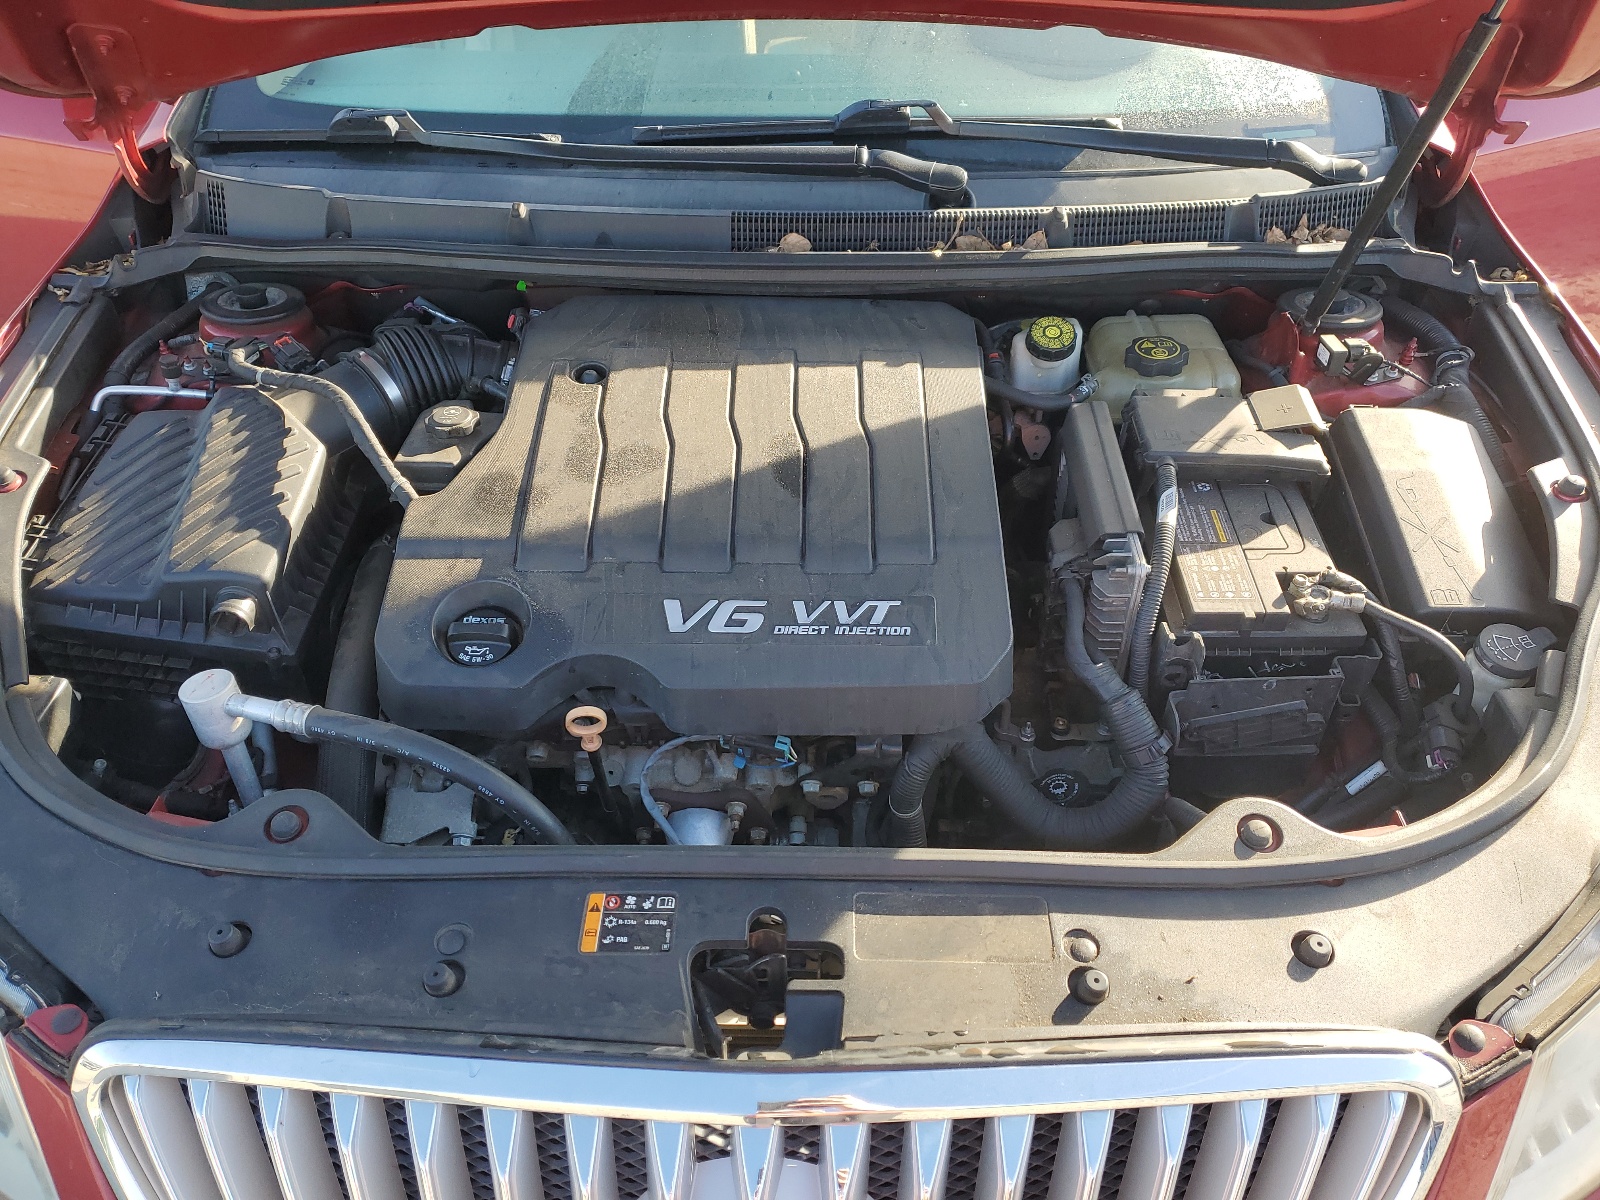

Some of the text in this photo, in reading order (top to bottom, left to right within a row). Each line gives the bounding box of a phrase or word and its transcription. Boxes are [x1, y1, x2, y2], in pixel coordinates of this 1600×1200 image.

[462, 615, 507, 624] dexos
[663, 599, 902, 633] V6 VVT
[773, 625, 911, 636] DIRECT INJECTION
[458, 652, 471, 662] SAE
